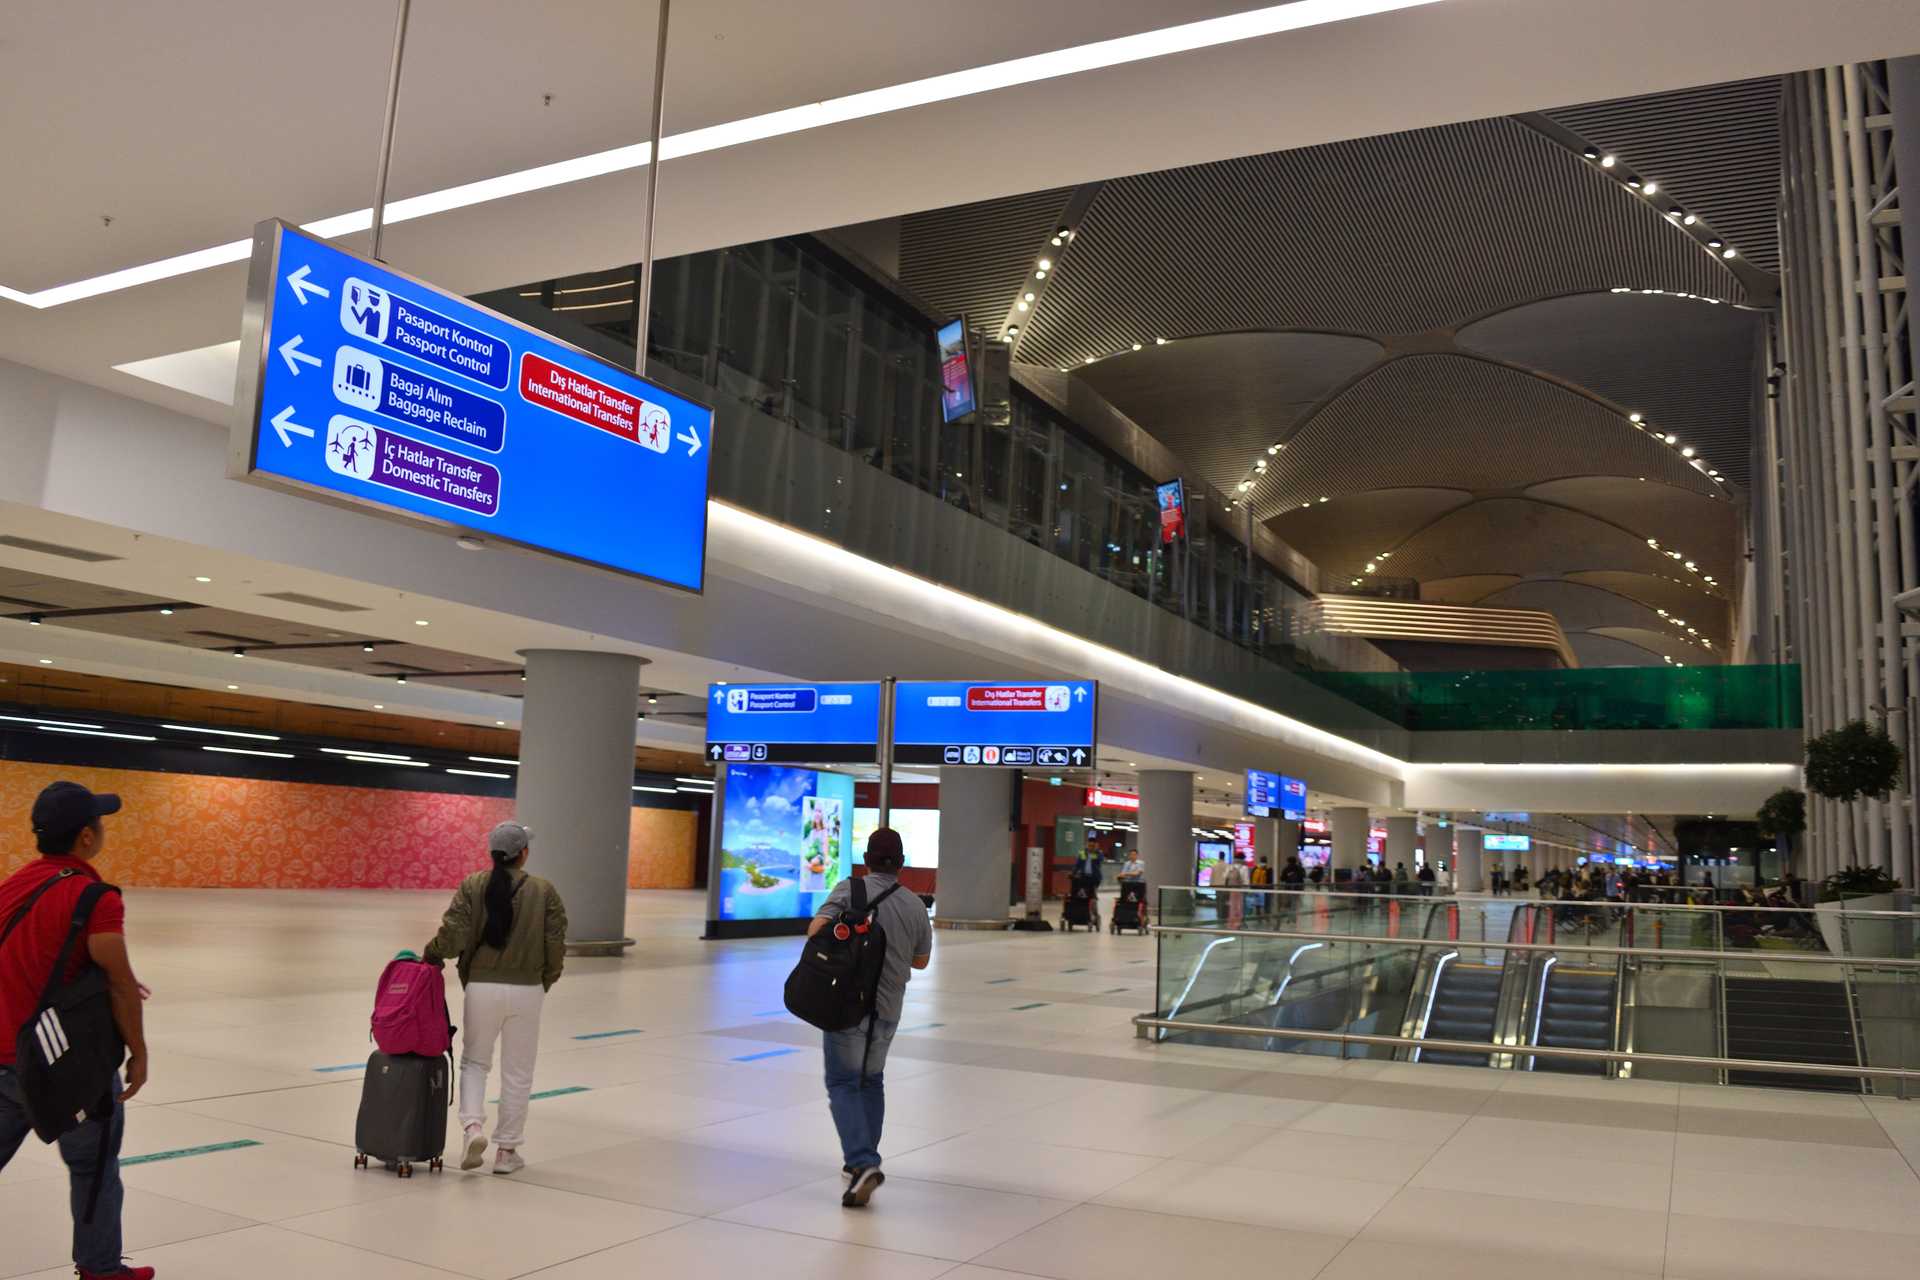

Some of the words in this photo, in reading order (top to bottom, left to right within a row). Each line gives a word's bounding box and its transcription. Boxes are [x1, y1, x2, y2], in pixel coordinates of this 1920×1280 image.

[396, 326, 447, 359] Passport
[448, 348, 490, 376] Control
[398, 306, 450, 340] Pasaport
[452, 329, 493, 357] Kontrol
[390, 372, 424, 400] Bagaj
[426, 386, 453, 408] Alım
[528, 378, 592, 415] International
[593, 404, 633, 431] Transfers
[550, 370, 566, 390] Dış
[568, 377, 597, 401] Hatlar
[598, 389, 634, 415] Transfer
[388, 391, 441, 423] Baggage
[443, 411, 487, 439] Reclaim
[382, 459, 440, 490] Domestic
[442, 477, 493, 505] Transfers
[384, 437, 395, 460] İç
[397, 444, 435, 469] Hatlar
[436, 456, 482, 483] Transfer
